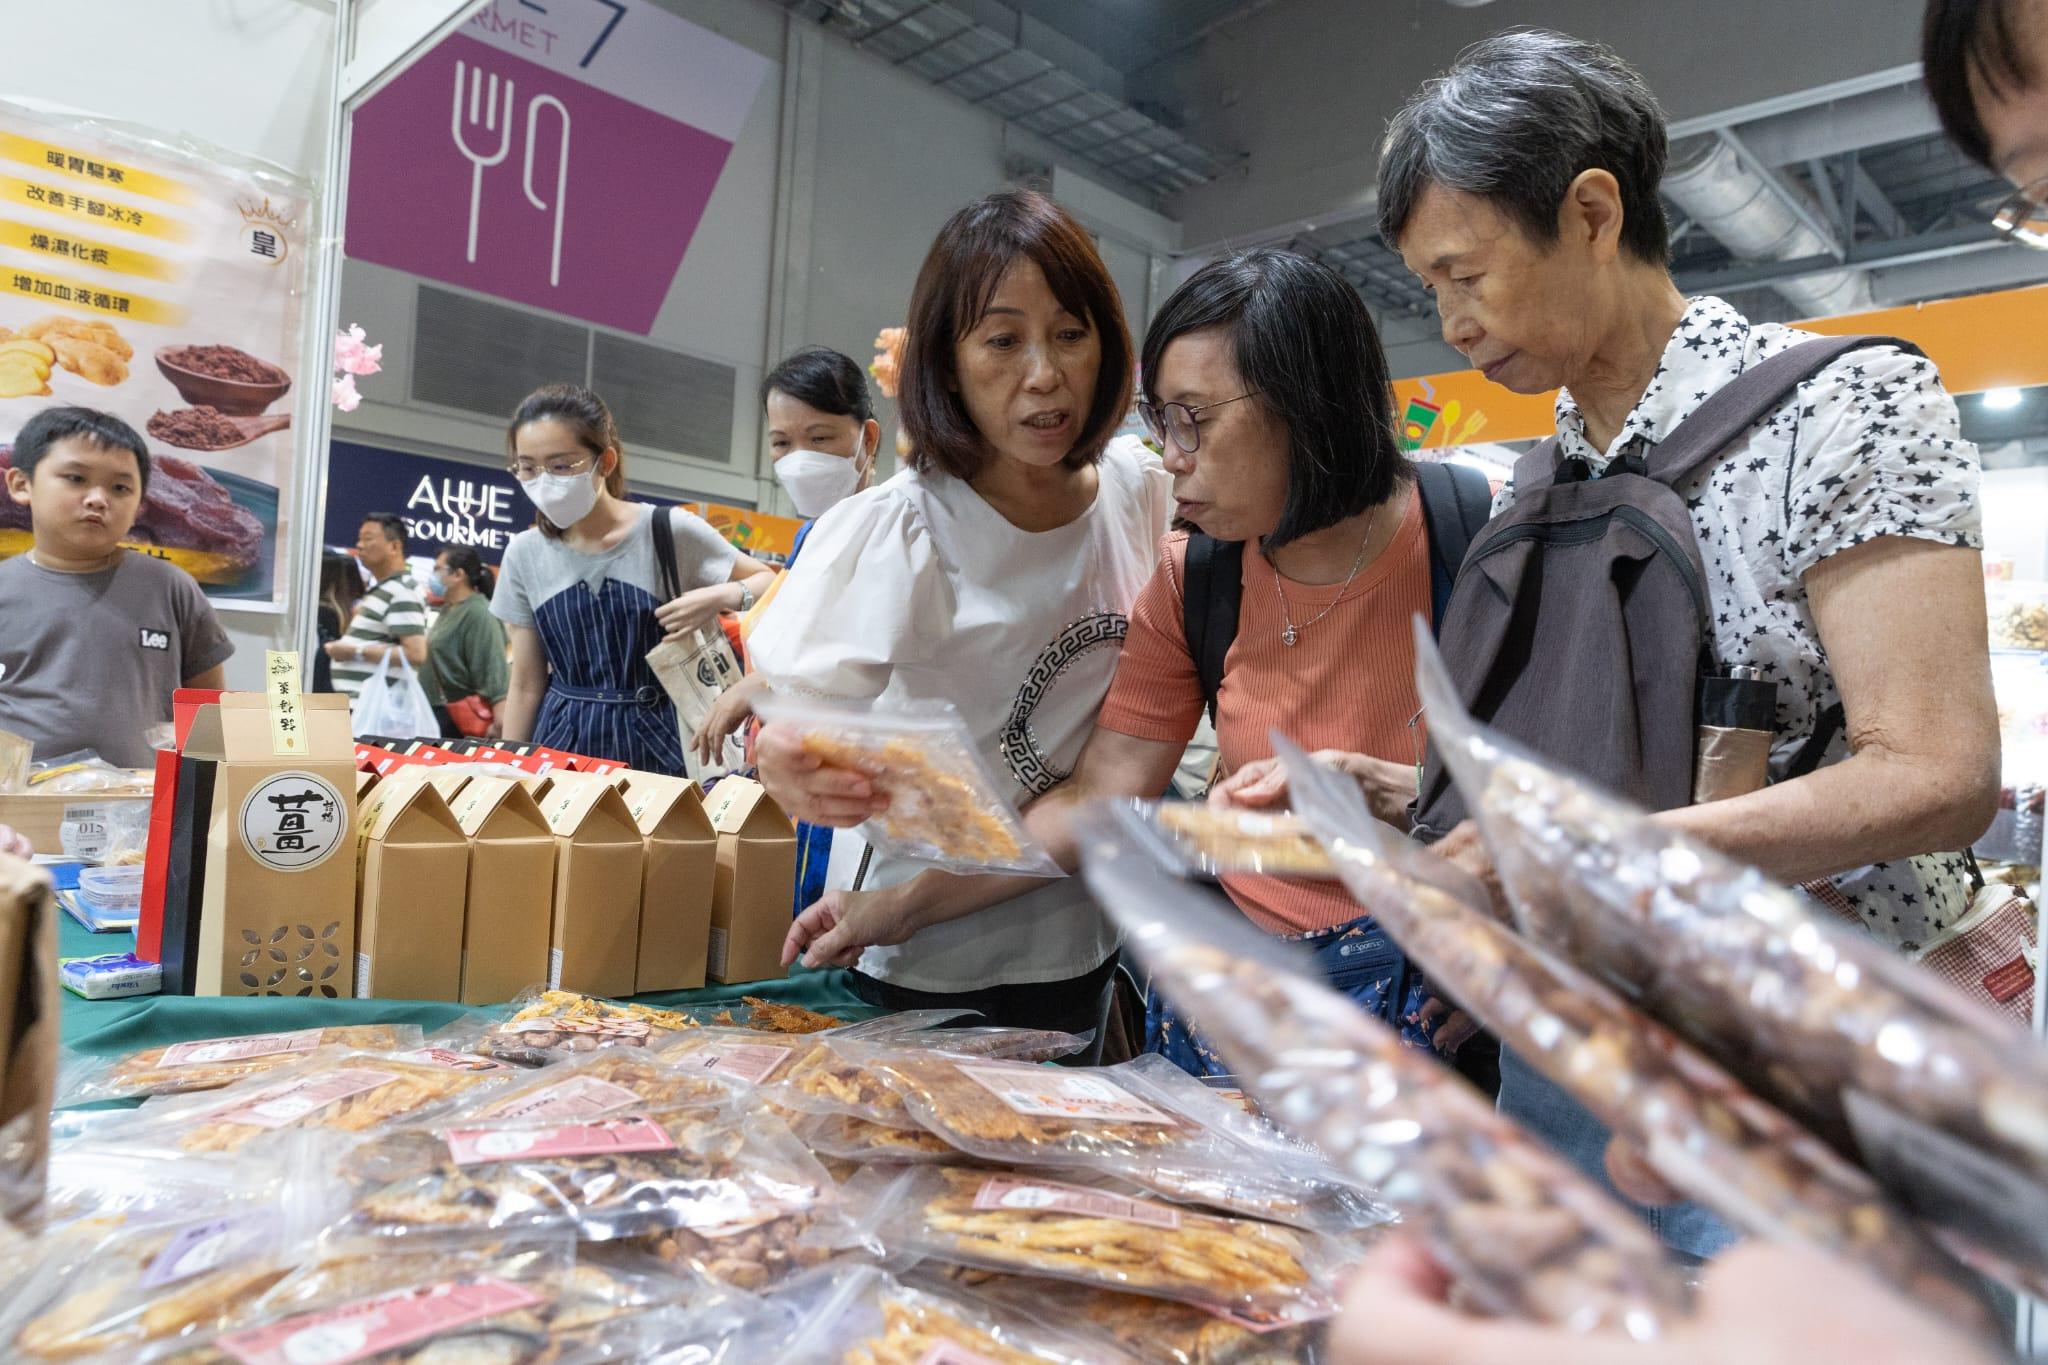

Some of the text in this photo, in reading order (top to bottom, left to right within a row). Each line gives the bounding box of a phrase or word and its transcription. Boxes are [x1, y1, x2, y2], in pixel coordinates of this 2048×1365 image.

[47, 150, 125, 184] 暖胃驅寒
[26, 184, 143, 226] 改善手腳冰冷
[30, 233, 109, 265] 燥濕化痰
[13, 274, 130, 313] 增加血液循環
[141, 629, 168, 649] Lee
